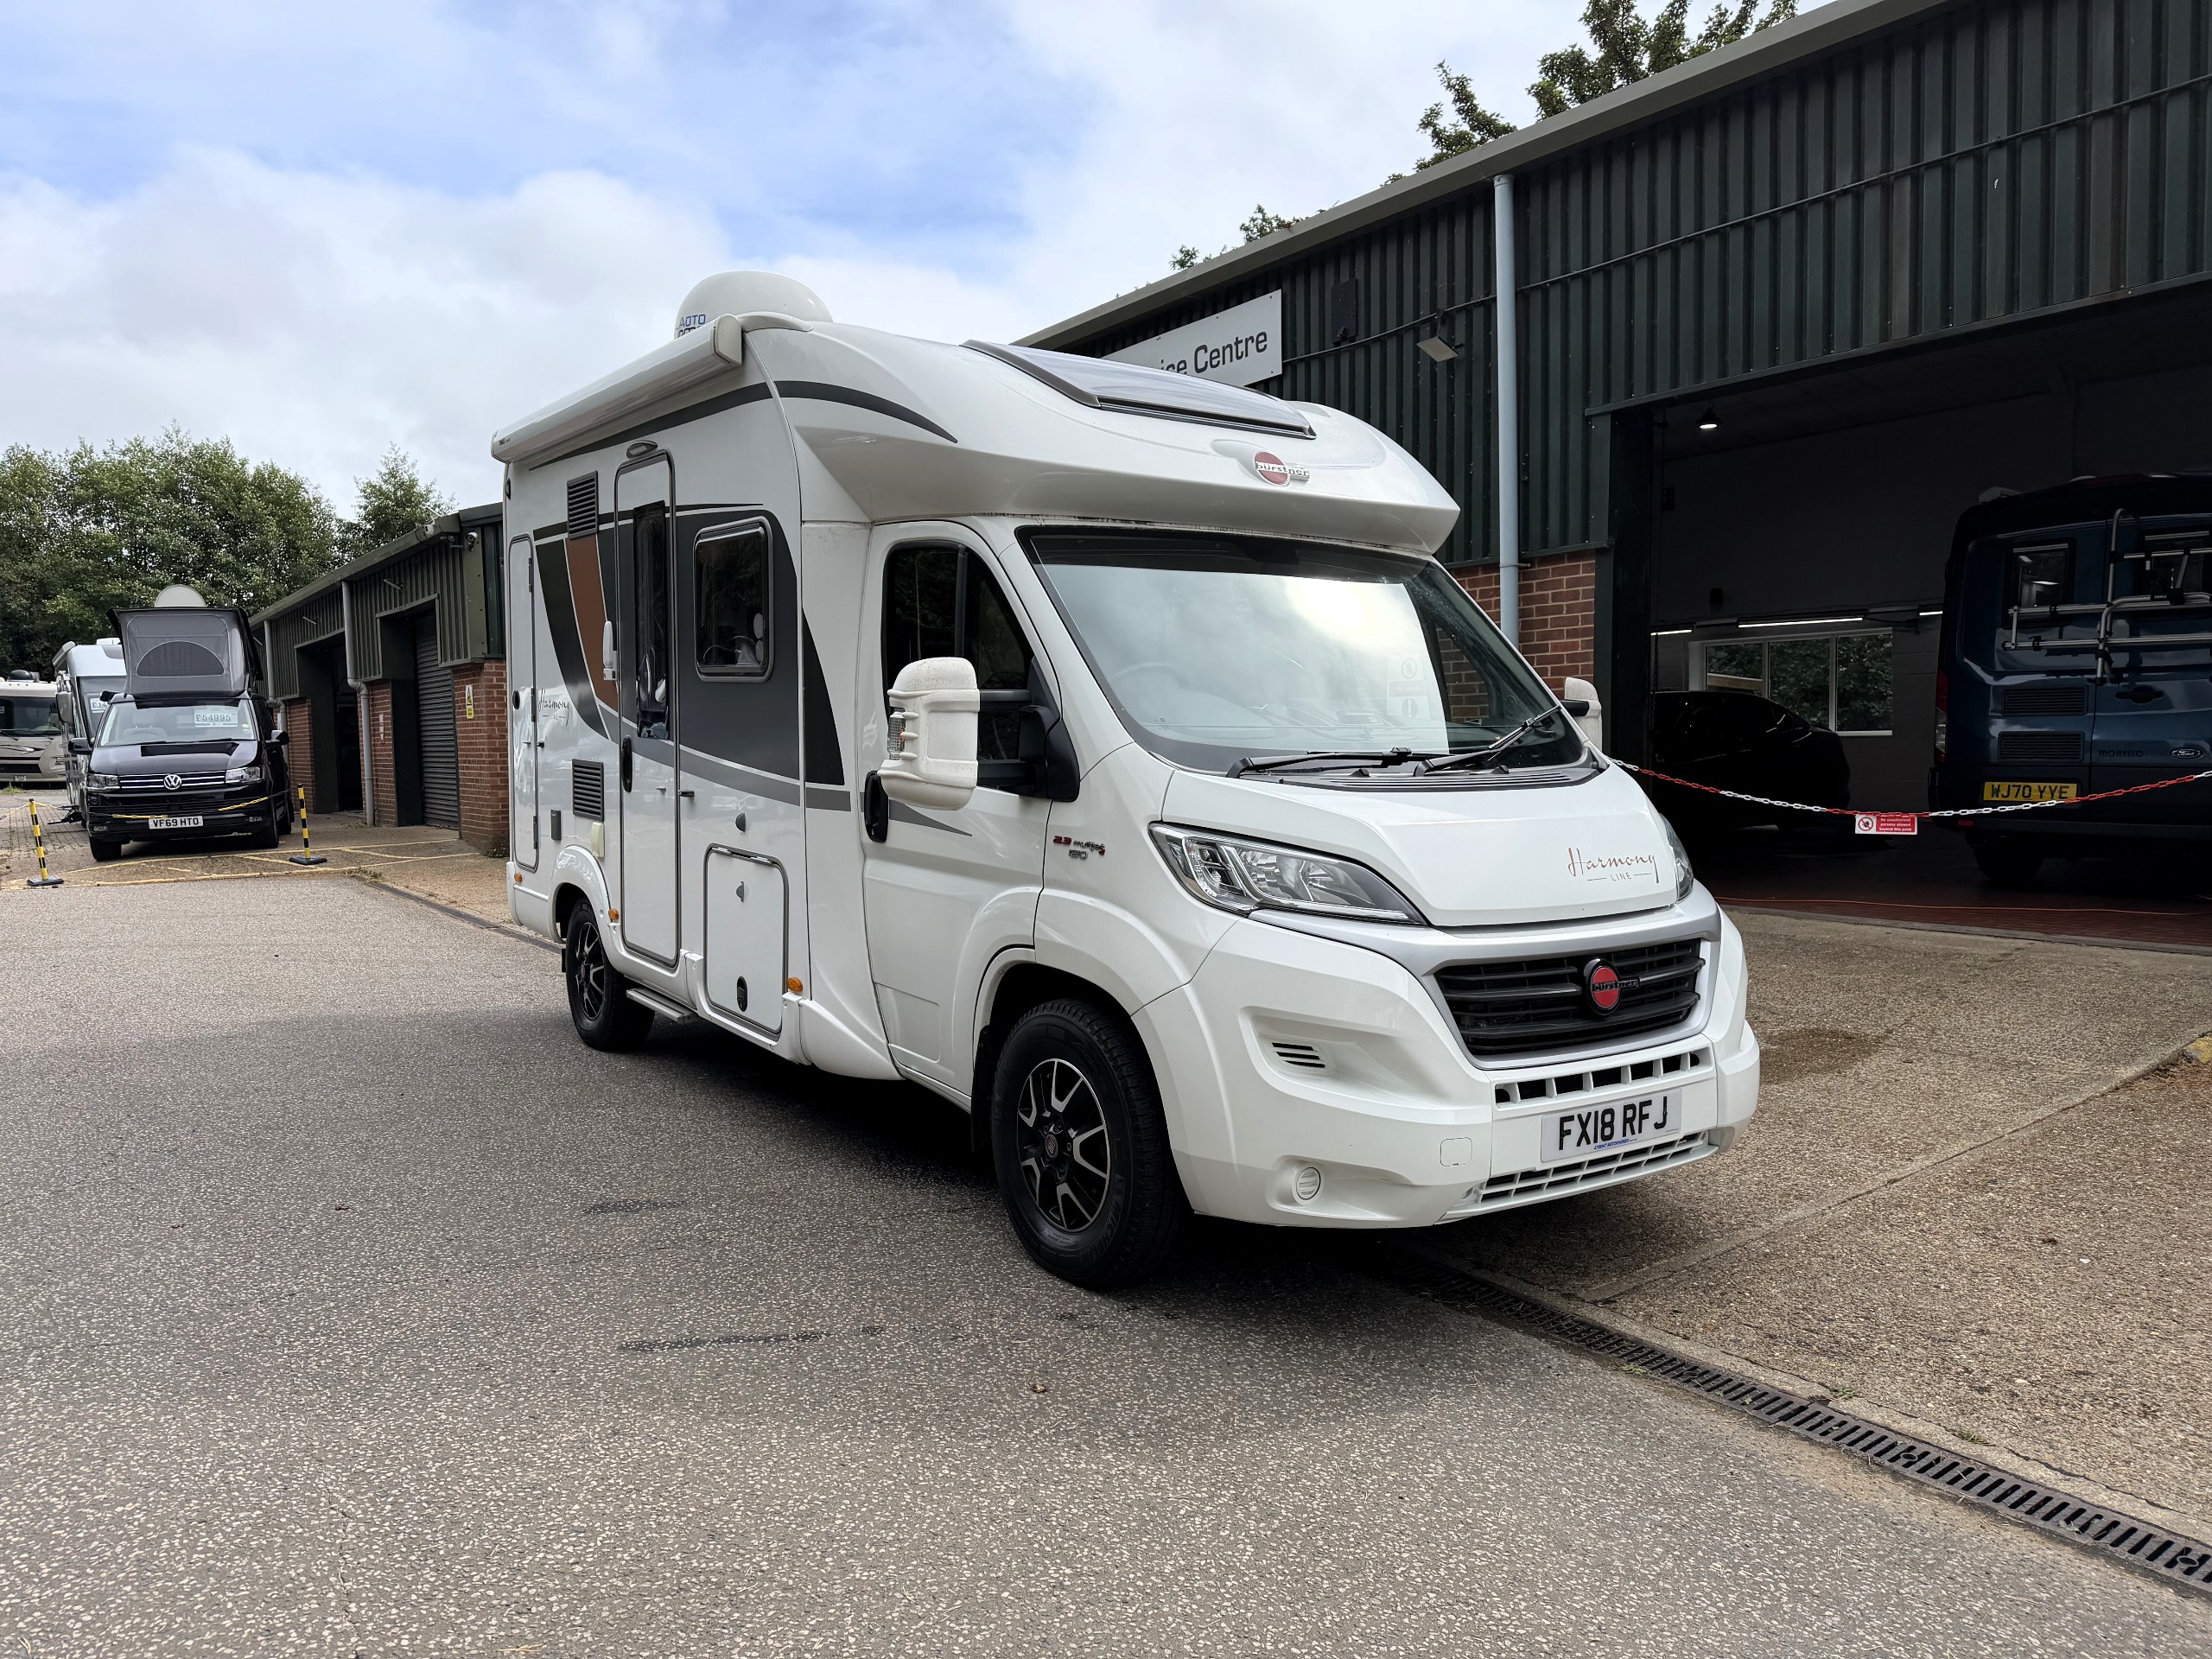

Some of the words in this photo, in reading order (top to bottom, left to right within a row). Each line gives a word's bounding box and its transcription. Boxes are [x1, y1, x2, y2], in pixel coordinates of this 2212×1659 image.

[1193, 331, 1268, 373] Centre
[1991, 784, 2032, 798] WJ70
[2037, 785, 2070, 799] YYE
[152, 818, 178, 828] VF69
[1567, 847, 1660, 883] Harmony
[1610, 872, 1632, 881] LINE
[1559, 1108, 1615, 1151] FX18
[1622, 1096, 1668, 1138] RFJ
